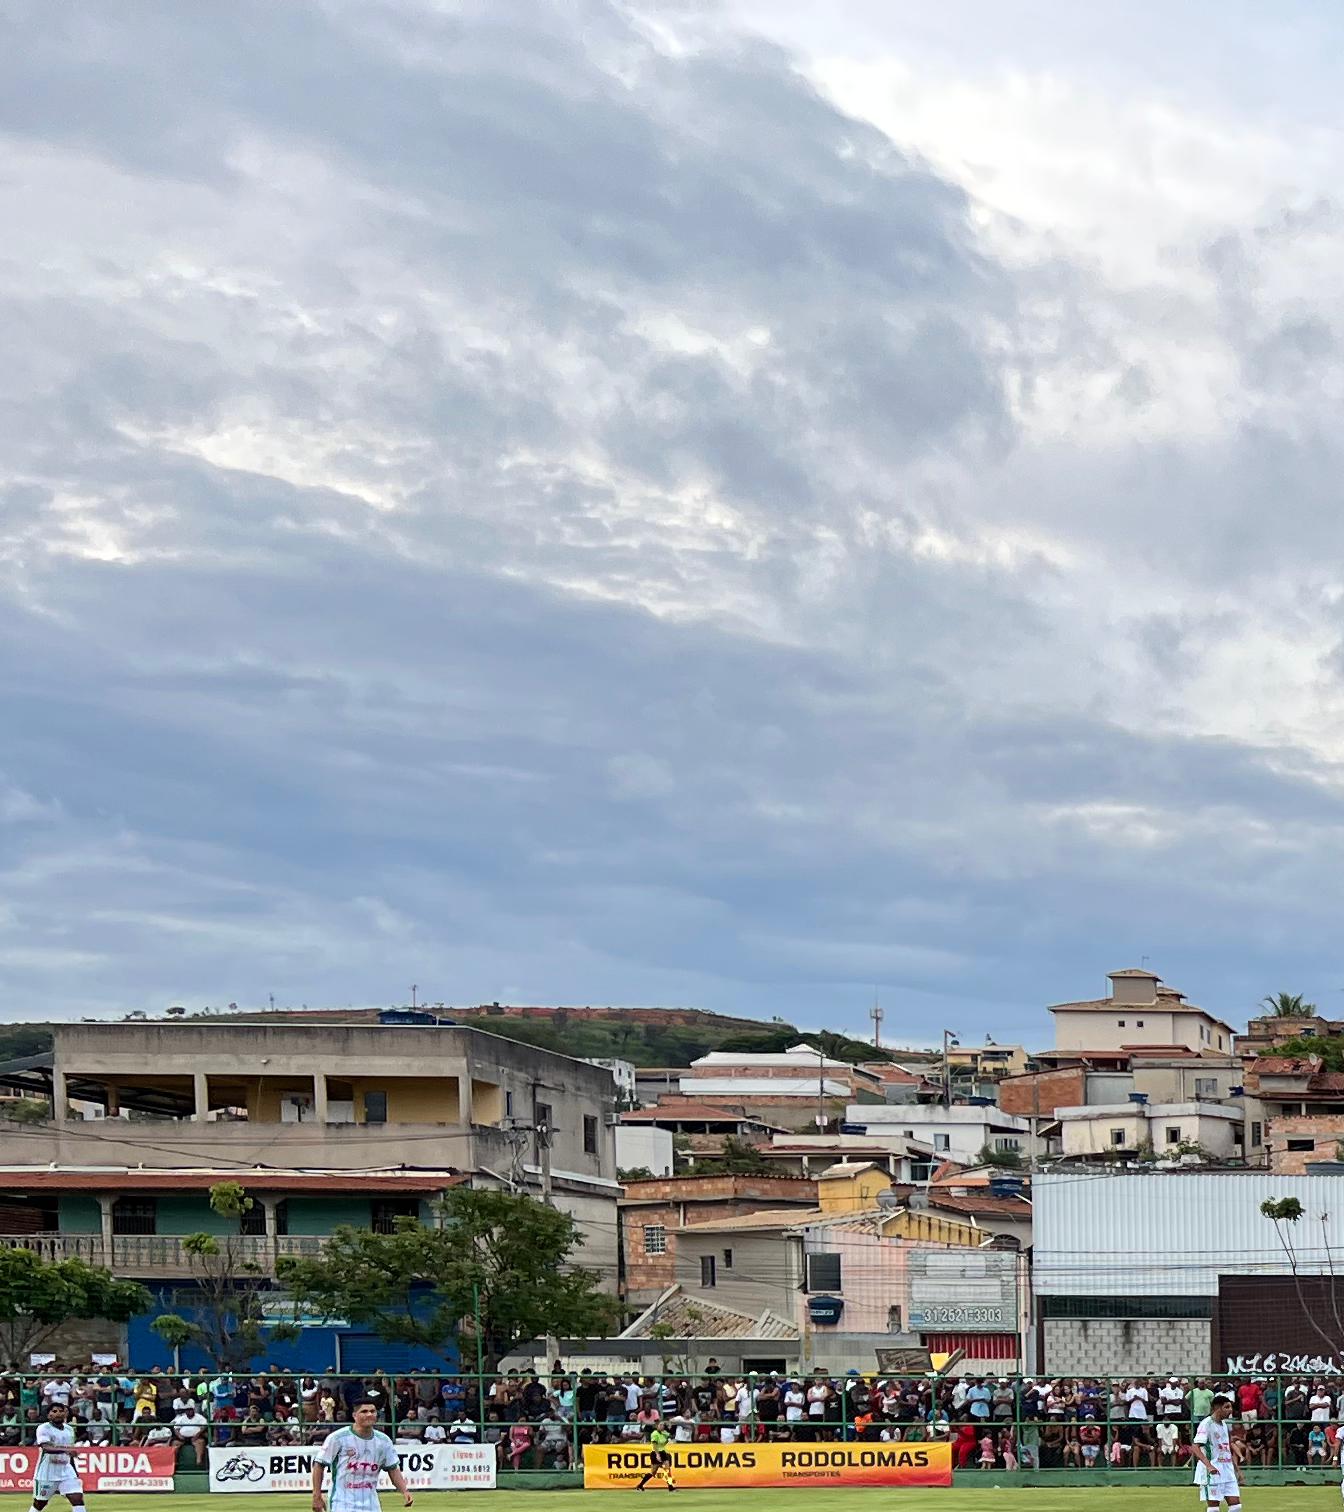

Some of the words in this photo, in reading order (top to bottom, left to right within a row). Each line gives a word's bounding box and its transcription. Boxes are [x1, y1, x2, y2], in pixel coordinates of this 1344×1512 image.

[77, 1452, 152, 1473] ENIDA
[607, 1452, 756, 1469] ROLOMAS
[781, 1451, 929, 1468] RODOLOMAS
